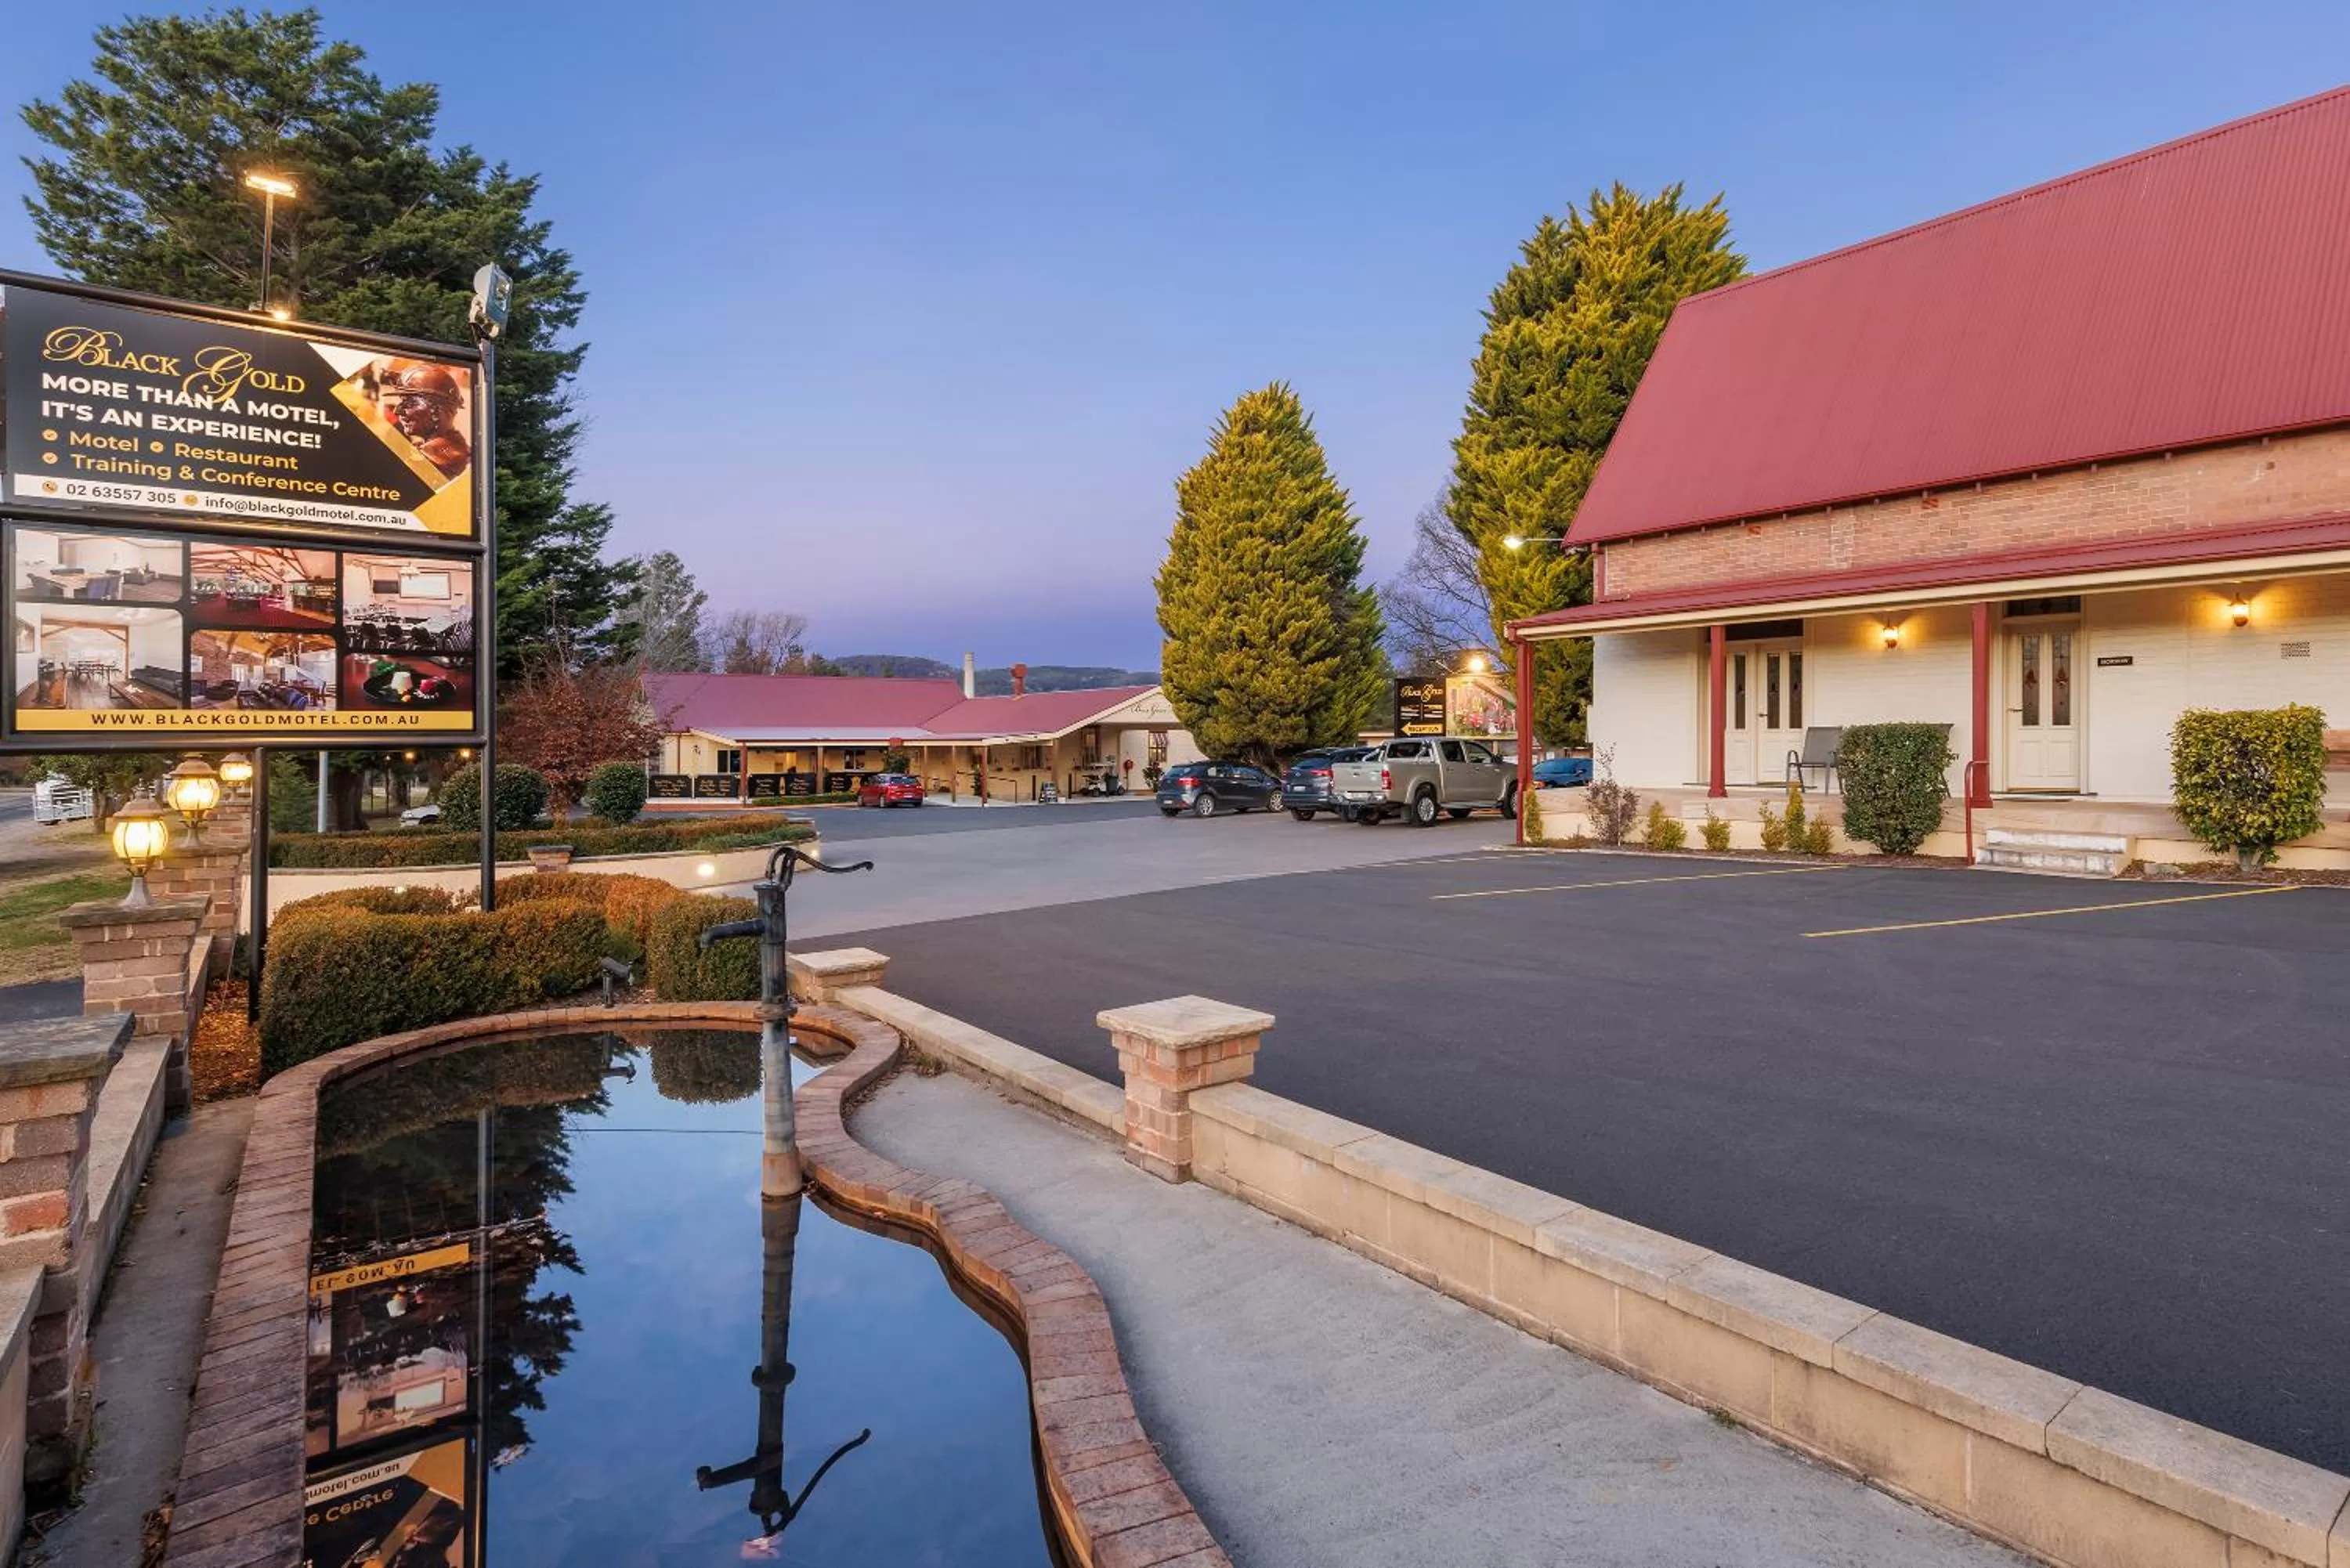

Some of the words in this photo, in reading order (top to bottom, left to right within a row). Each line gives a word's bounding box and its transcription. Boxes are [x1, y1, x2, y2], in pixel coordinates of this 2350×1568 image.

[43, 327, 180, 377] BLACK
[183, 346, 306, 403] GOLD
[42, 372, 130, 399] MORE
[136, 385, 213, 411] THAN
[220, 398, 241, 415] A
[247, 400, 341, 430] MOTEL,
[42, 400, 94, 421] IT'S
[100, 408, 143, 429] AN
[151, 415, 322, 450] EXPERIENCE!
[69, 431, 139, 452] Motel
[174, 443, 298, 471] Restaurant
[70, 453, 172, 481] Training
[179, 464, 195, 480] &
[201, 468, 327, 494] Conference
[332, 482, 402, 501] Centre
[66, 483, 87, 496] 02
[92, 486, 142, 500] 63557
[146, 491, 177, 504] 305
[205, 496, 407, 526] info@blackgoldmotel.com.au
[91, 714, 421, 725] WWW.BLACKGOLDMOTEL.COM.AU
